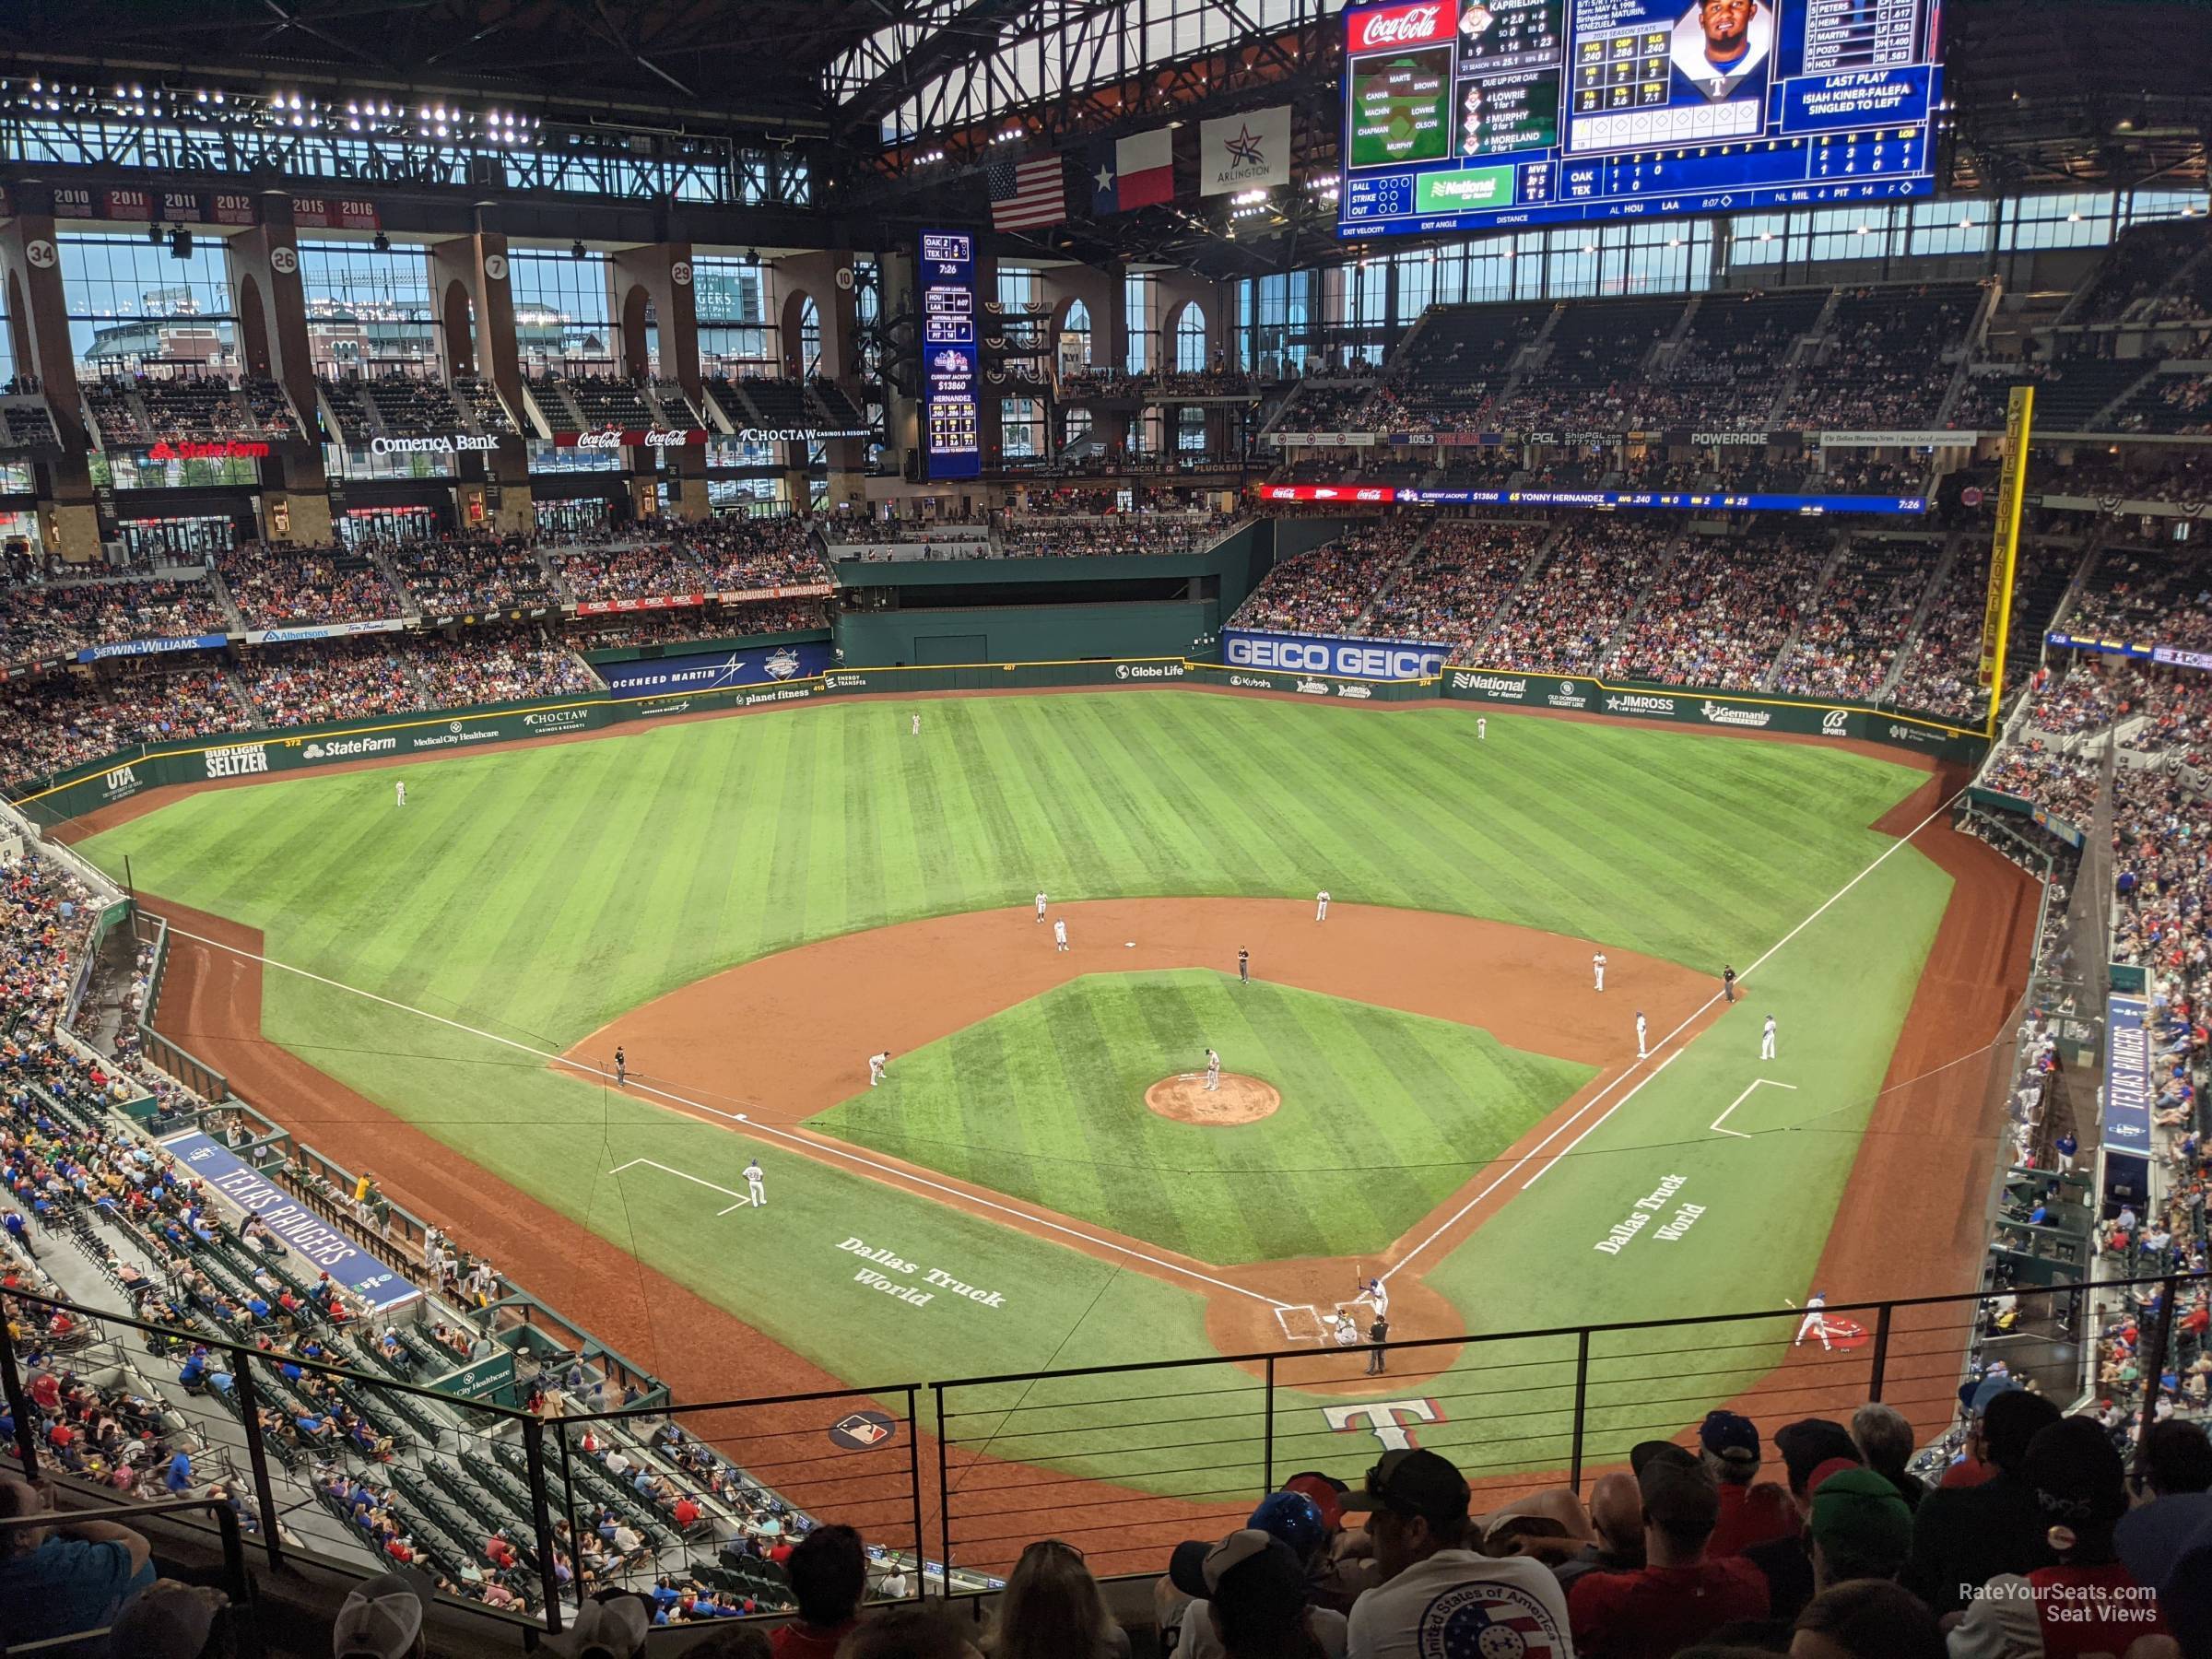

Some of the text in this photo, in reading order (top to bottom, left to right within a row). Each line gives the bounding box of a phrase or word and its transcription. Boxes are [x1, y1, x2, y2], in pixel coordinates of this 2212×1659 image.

[1819, 2, 1850, 13] PETERS
[1363, 6, 1441, 44] Coca-Cola
[1576, 20, 1617, 31] VENEZUELA
[1818, 18, 1839, 27] HEIM
[1818, 30, 1849, 41] MARTIN
[1816, 45, 1841, 55] POZO
[1815, 59, 1838, 69] HOLT
[1389, 74, 1411, 83] MARTE
[1482, 78, 1497, 87] DUE
[1508, 76, 1522, 84] FOR
[1523, 74, 1538, 82] OAK
[1826, 72, 1888, 88] LAST PLAY
[1414, 81, 1438, 90] BROWN
[1366, 91, 1389, 100] CANHA
[1493, 90, 1525, 101] LOWRIE
[1803, 85, 1910, 104] ISIAH KINER-FALEFA
[1411, 106, 1435, 115] LOWRIE
[1809, 98, 1900, 115] SINGLED TO LEFT
[1492, 111, 1529, 123] MURPHY
[1358, 126, 1389, 135] CHAPMAN
[1416, 120, 1437, 129] OLSON
[1491, 133, 1539, 145] MORELAND
[1387, 141, 1413, 150] MURPHY
[1218, 165, 1269, 182] ARLINGTON
[1571, 171, 1594, 182] OAK
[1352, 182, 1370, 191] BALL
[1445, 177, 1496, 194] National
[1571, 185, 1591, 195] TEX
[54, 190, 88, 204] 2010
[112, 191, 143, 206] 2011
[1352, 194, 1376, 203] STRIKE
[1792, 188, 1850, 200] MIL PIT
[165, 194, 196, 208] 2011
[218, 195, 251, 209] 2012
[293, 199, 324, 213] 2015
[1624, 201, 1678, 213] HOU LAA
[342, 202, 372, 215] 2016
[1352, 206, 1368, 215] OUT
[1497, 215, 1528, 224] DISTANCE
[31, 247, 53, 263] 34
[274, 253, 294, 267] 26
[492, 261, 501, 274] 7
[675, 266, 689, 280] 29
[939, 265, 956, 274] 7:26
[840, 273, 851, 285] 10
[938, 381, 966, 390] $13860
[578, 431, 622, 449] Coca-Cola
[645, 430, 688, 446] Coca-Cola
[747, 429, 816, 441] CHOCTAW
[1407, 434, 1434, 444] 105.3
[1531, 433, 1559, 443] PGL
[1691, 433, 1769, 444] POWERADE
[456, 434, 500, 450] Bank
[1273, 488, 1295, 499] Coca-Cola
[1357, 489, 1381, 500] Coca-Cola
[1522, 493, 1550, 501] YONNY
[1553, 494, 1604, 502] HERNANDEZ
[1899, 500, 1920, 510] 7:26
[722, 583, 830, 603] WHATABURGER WHATABURGER
[588, 601, 609, 610] DEX
[617, 599, 638, 608] DEX
[644, 597, 665, 606] DEX
[672, 595, 692, 604] DEX
[345, 623, 361, 633] Tom
[280, 629, 329, 642] Albertsons
[1228, 638, 1440, 679] GEICO GEICO
[8, 668, 26, 677] TOYOTA
[671, 669, 716, 681] MARTIN
[1131, 665, 1184, 677] Globe Life
[1242, 677, 1271, 688] Kubota
[746, 688, 809, 706] planet fitness
[1500, 691, 1523, 700] Rental
[530, 710, 588, 725] CHOCTAW
[1719, 707, 1769, 722] Germania
[414, 729, 500, 747] Medical City Healthcare
[1822, 728, 1846, 736] SPORTS
[285, 738, 301, 747] 372
[205, 744, 265, 759] BUD LIGHT
[206, 751, 268, 778] SELTZER
[107, 767, 135, 790] UTA
[2111, 1025, 2145, 1110] TEXAS RANGERS
[214, 1168, 357, 1265] TEXAS RANGERS
[1593, 1173, 1688, 1255] Dallas Truck
[1653, 1203, 1707, 1241] World
[835, 1237, 1006, 1308] Dallas Truck
[853, 1267, 935, 1307] World
[457, 1370, 510, 1396] City Healthcare
[1322, 1396, 1443, 1451] T
[1437, 1588, 1482, 1615] States
[1486, 1588, 1502, 1598] of
[1507, 1591, 1556, 1641] America
